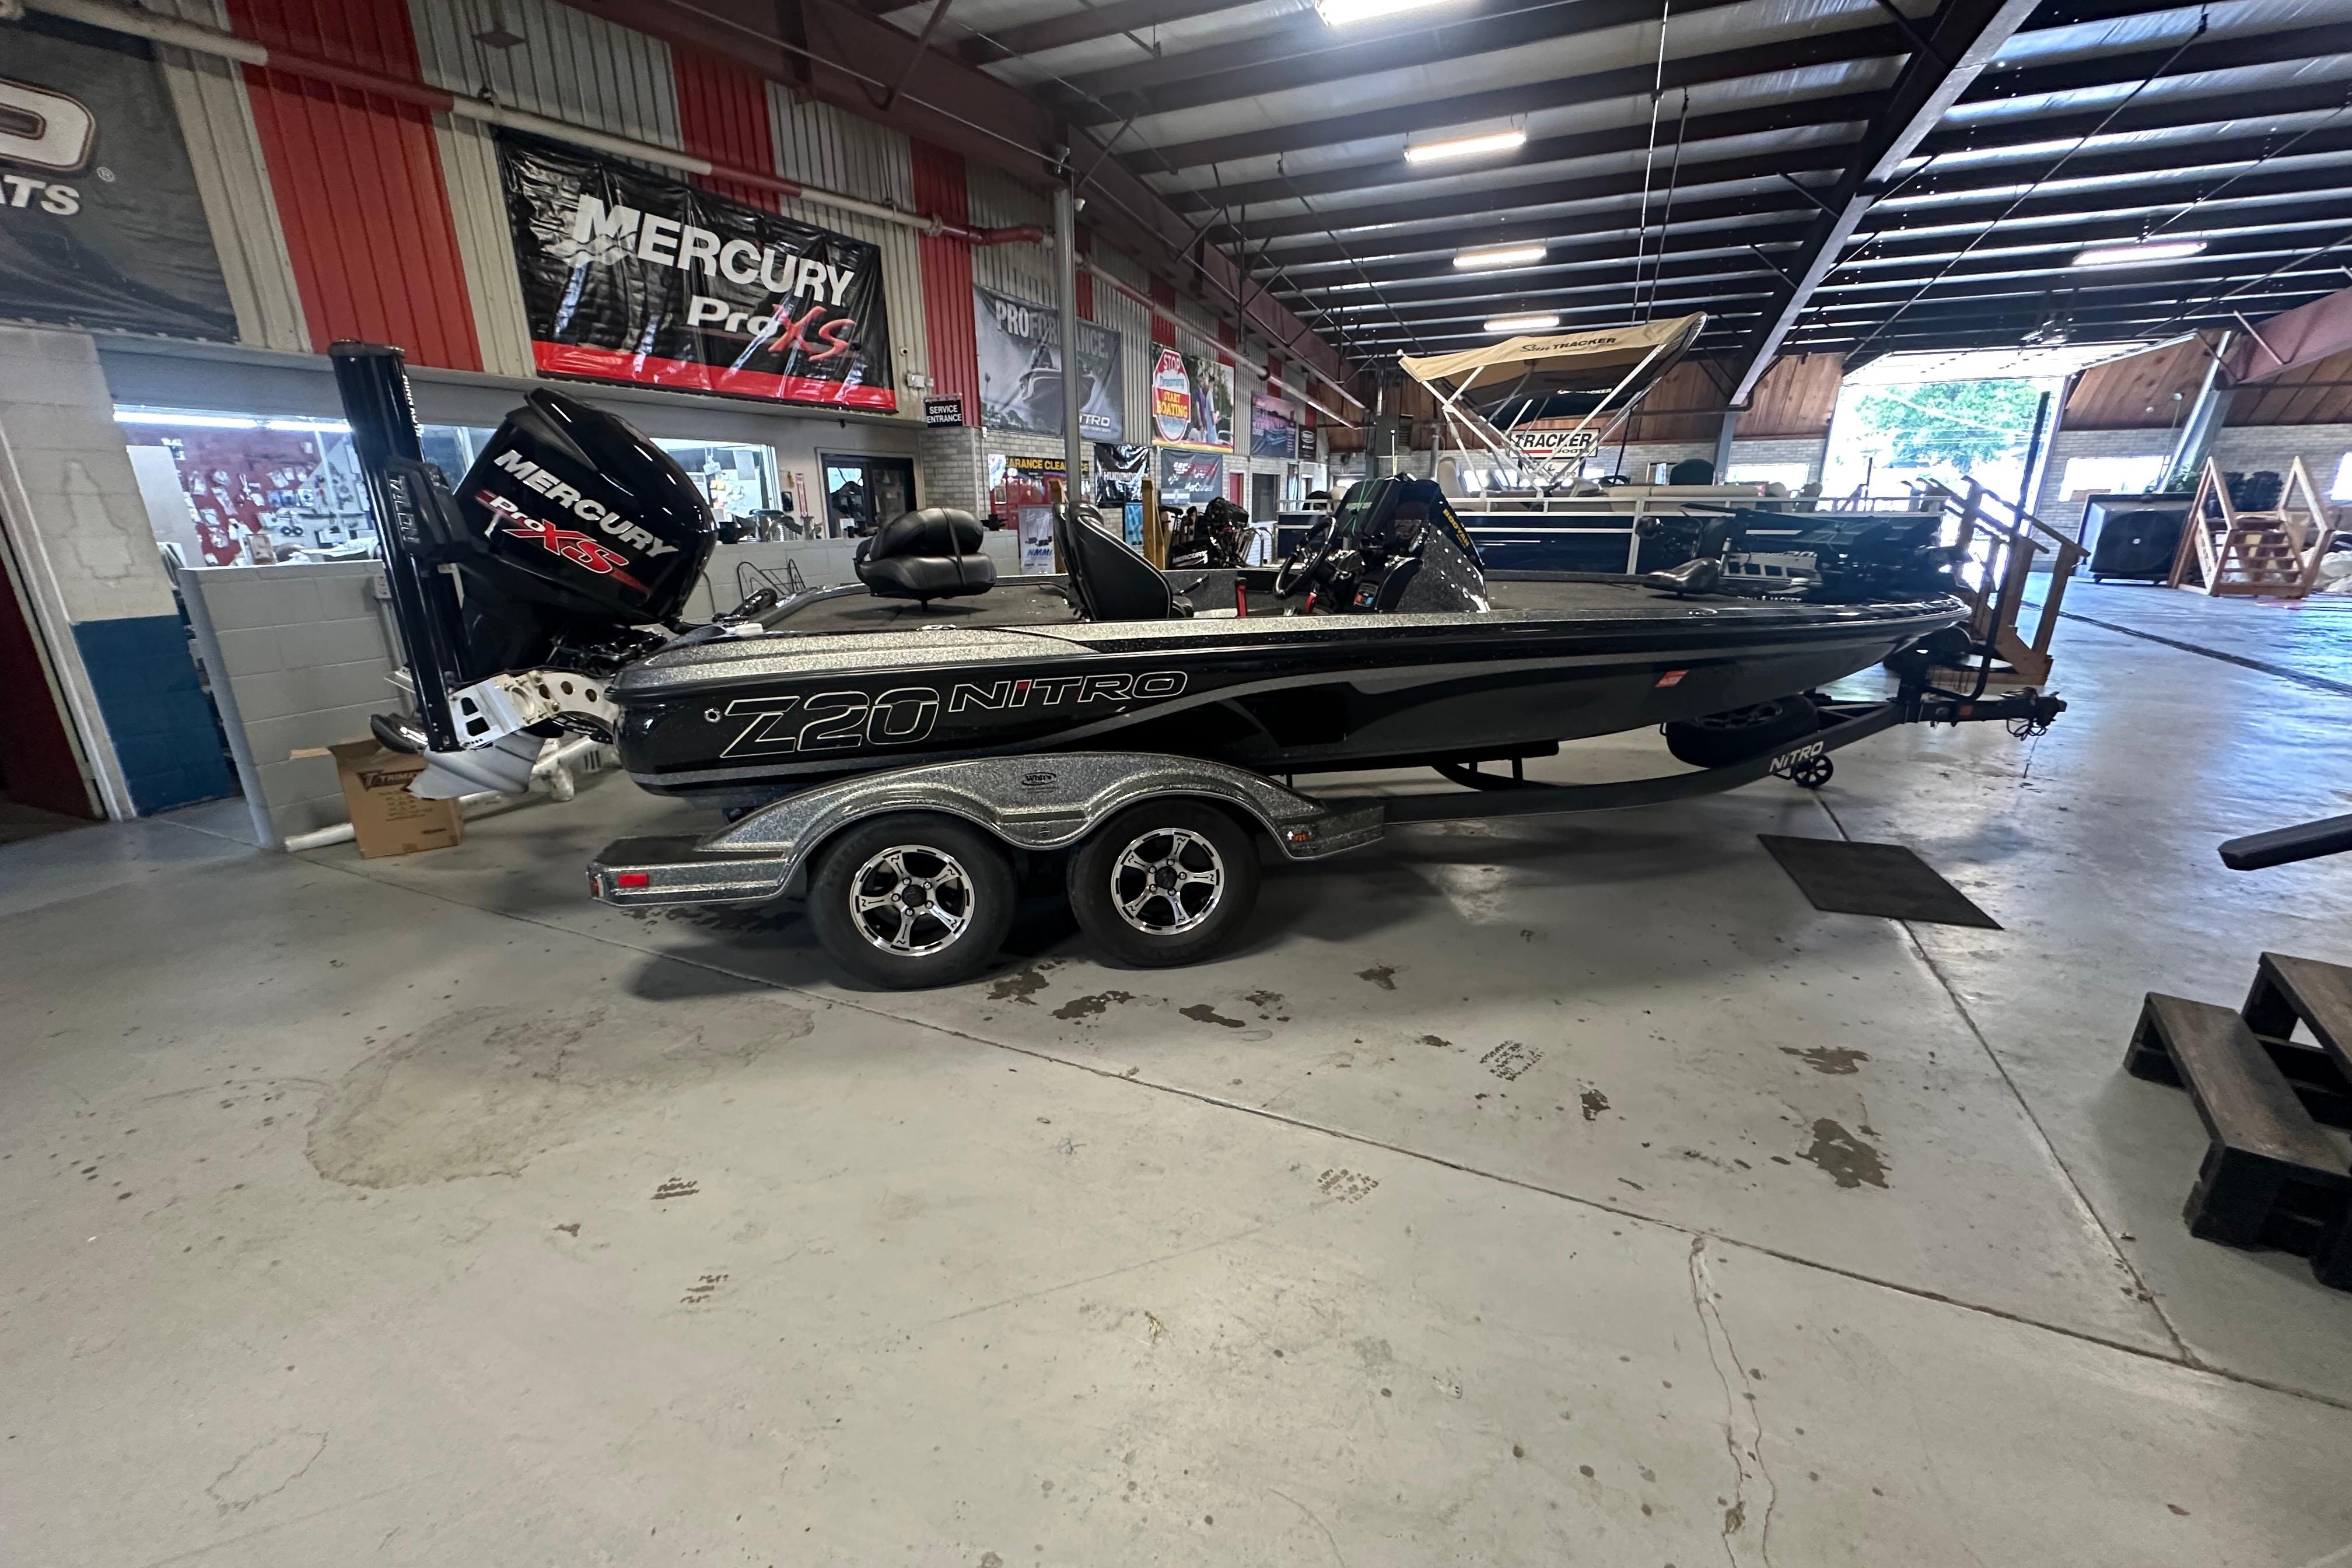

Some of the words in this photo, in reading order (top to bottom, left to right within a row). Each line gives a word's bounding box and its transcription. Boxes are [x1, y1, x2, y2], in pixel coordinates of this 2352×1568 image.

[572, 194, 855, 307] MERCURY
[1553, 338, 1617, 349] TRACKER
[1163, 354, 1181, 372] STOP
[1163, 391, 1181, 403] START
[929, 405, 958, 414] SERVICE
[1156, 400, 1188, 418] BOATING
[926, 414, 962, 424] ENTRANCE
[1515, 433, 1592, 447] TRACKER
[494, 449, 680, 558] MERCURY
[1443, 509, 1469, 547] BOOYAH
[1172, 550, 1208, 564] MERCURY
[719, 687, 940, 758] Z20
[949, 671, 1188, 713] NITRO
[1769, 740, 1824, 773] NITRO
